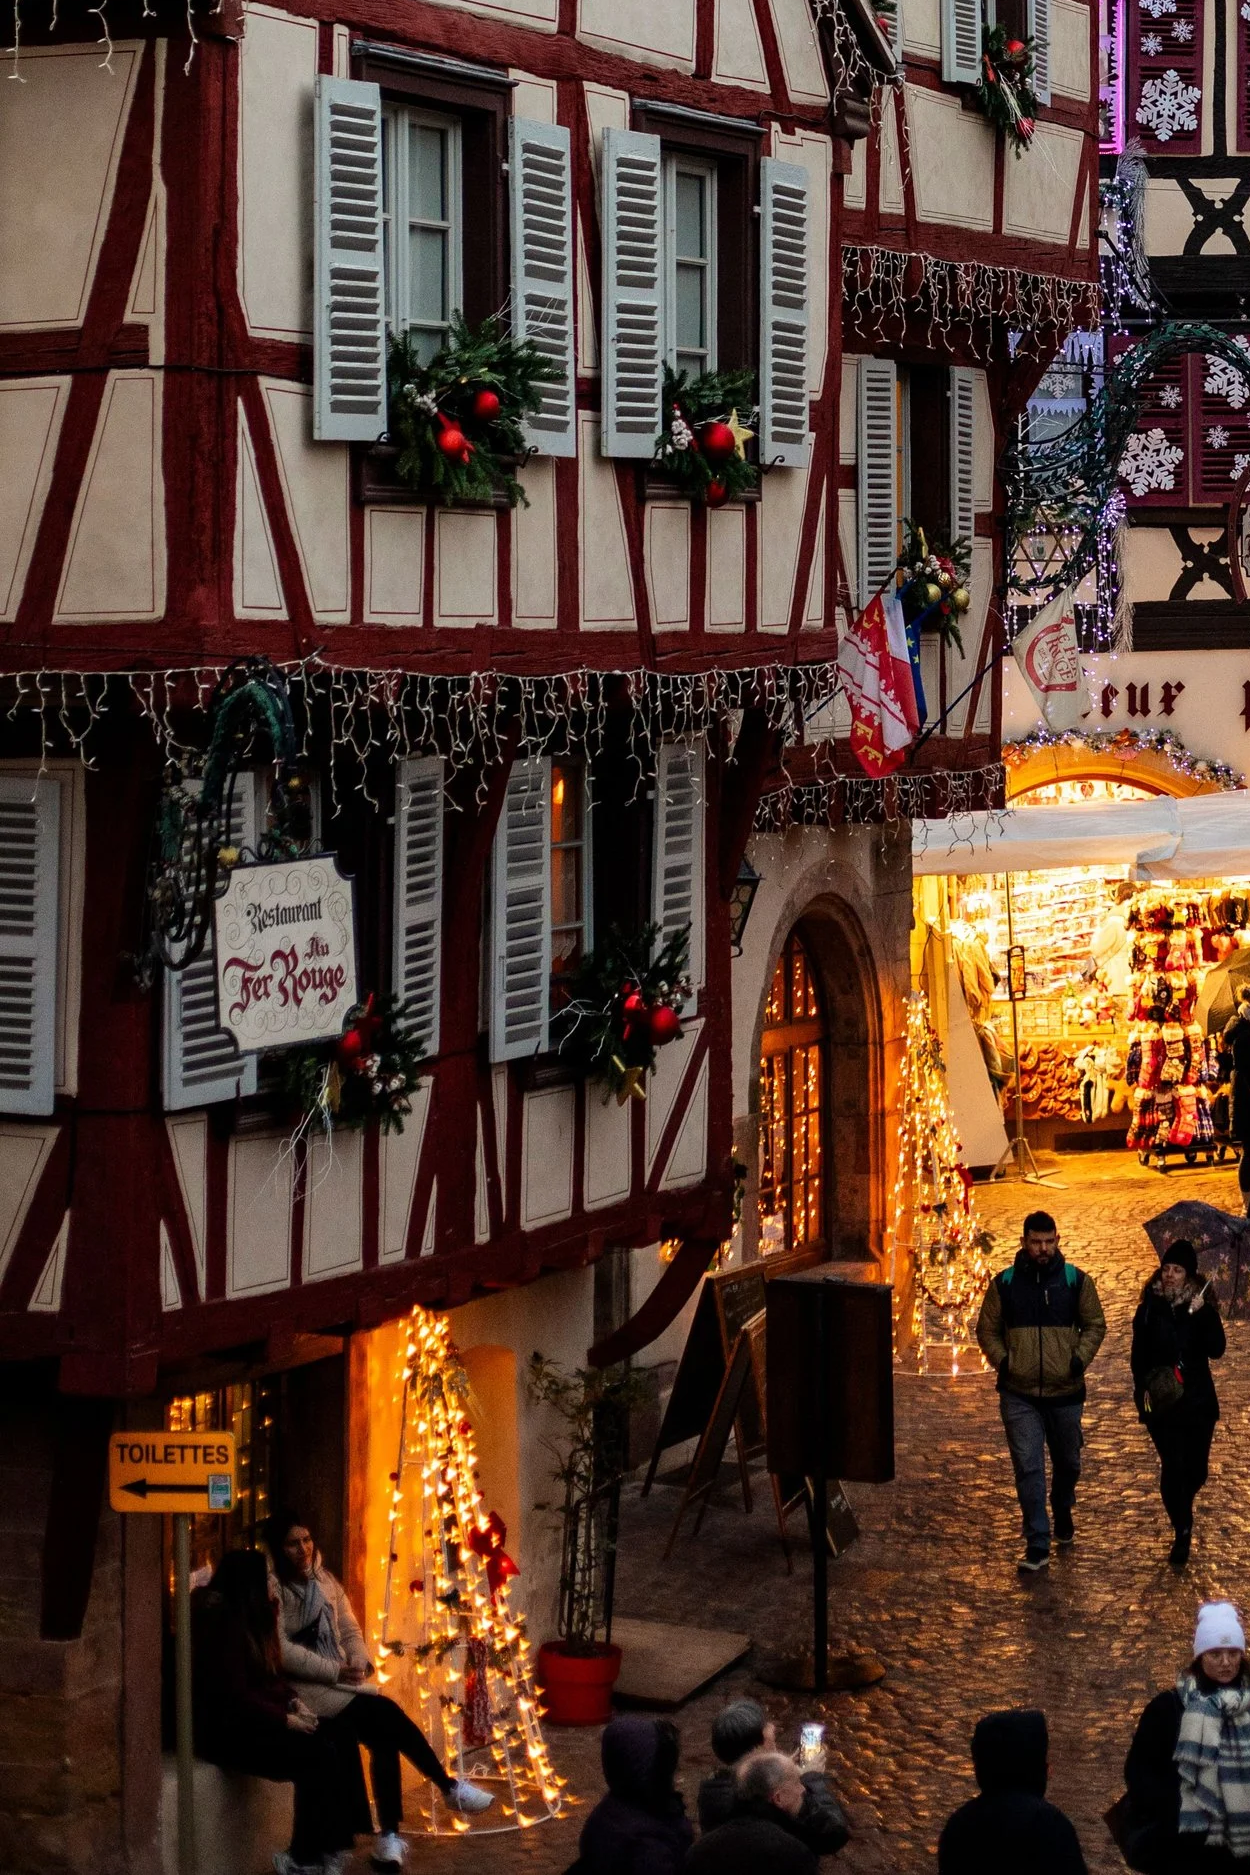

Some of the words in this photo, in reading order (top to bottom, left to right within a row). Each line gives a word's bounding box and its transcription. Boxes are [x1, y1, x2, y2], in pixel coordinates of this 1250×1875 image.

[1081, 677, 1186, 719] eux
[246, 896, 322, 934] Restaurant
[304, 936, 330, 959] Au
[223, 956, 273, 1022] Fer
[270, 944, 347, 1007] Rouge
[116, 1444, 229, 1464] TOILETTES
